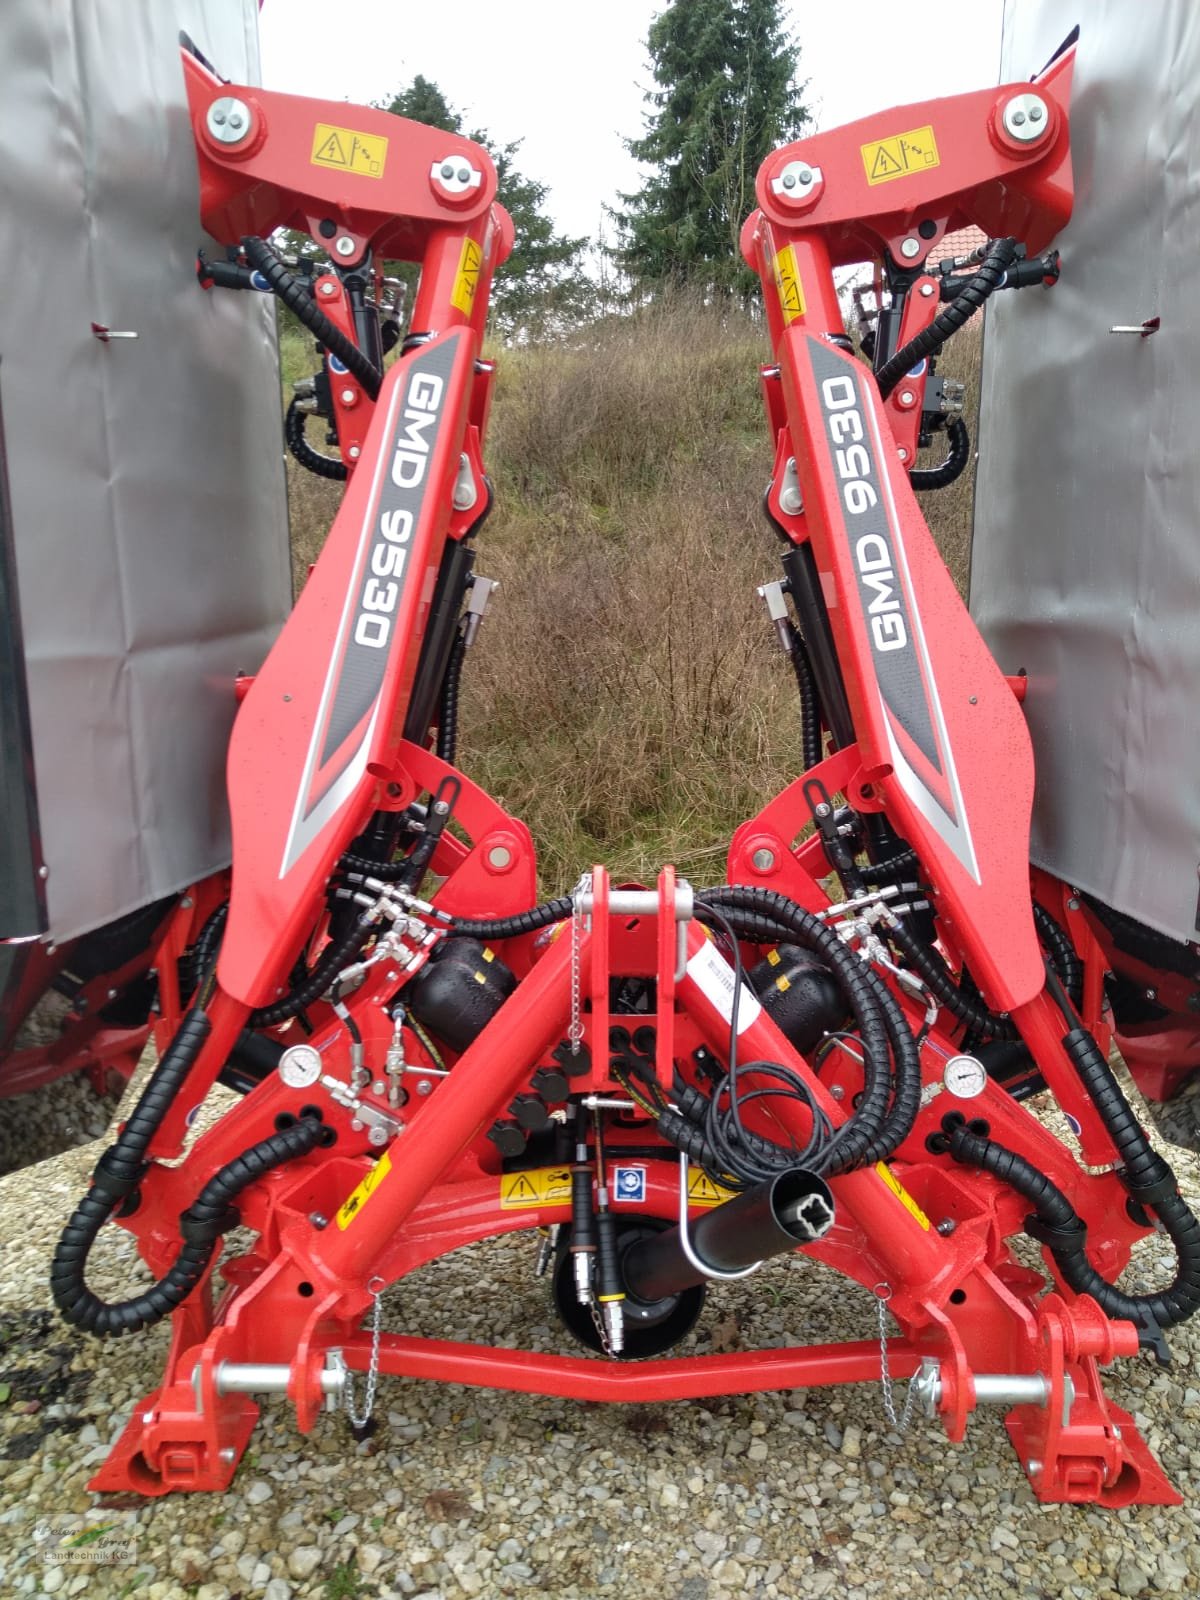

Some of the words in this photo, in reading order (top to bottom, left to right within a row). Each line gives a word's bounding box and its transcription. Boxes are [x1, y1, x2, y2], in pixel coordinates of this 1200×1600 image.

[391, 372, 444, 488] GMD
[822, 375, 878, 515] 9530
[354, 509, 414, 649] 9530
[855, 533, 907, 652] GMD
